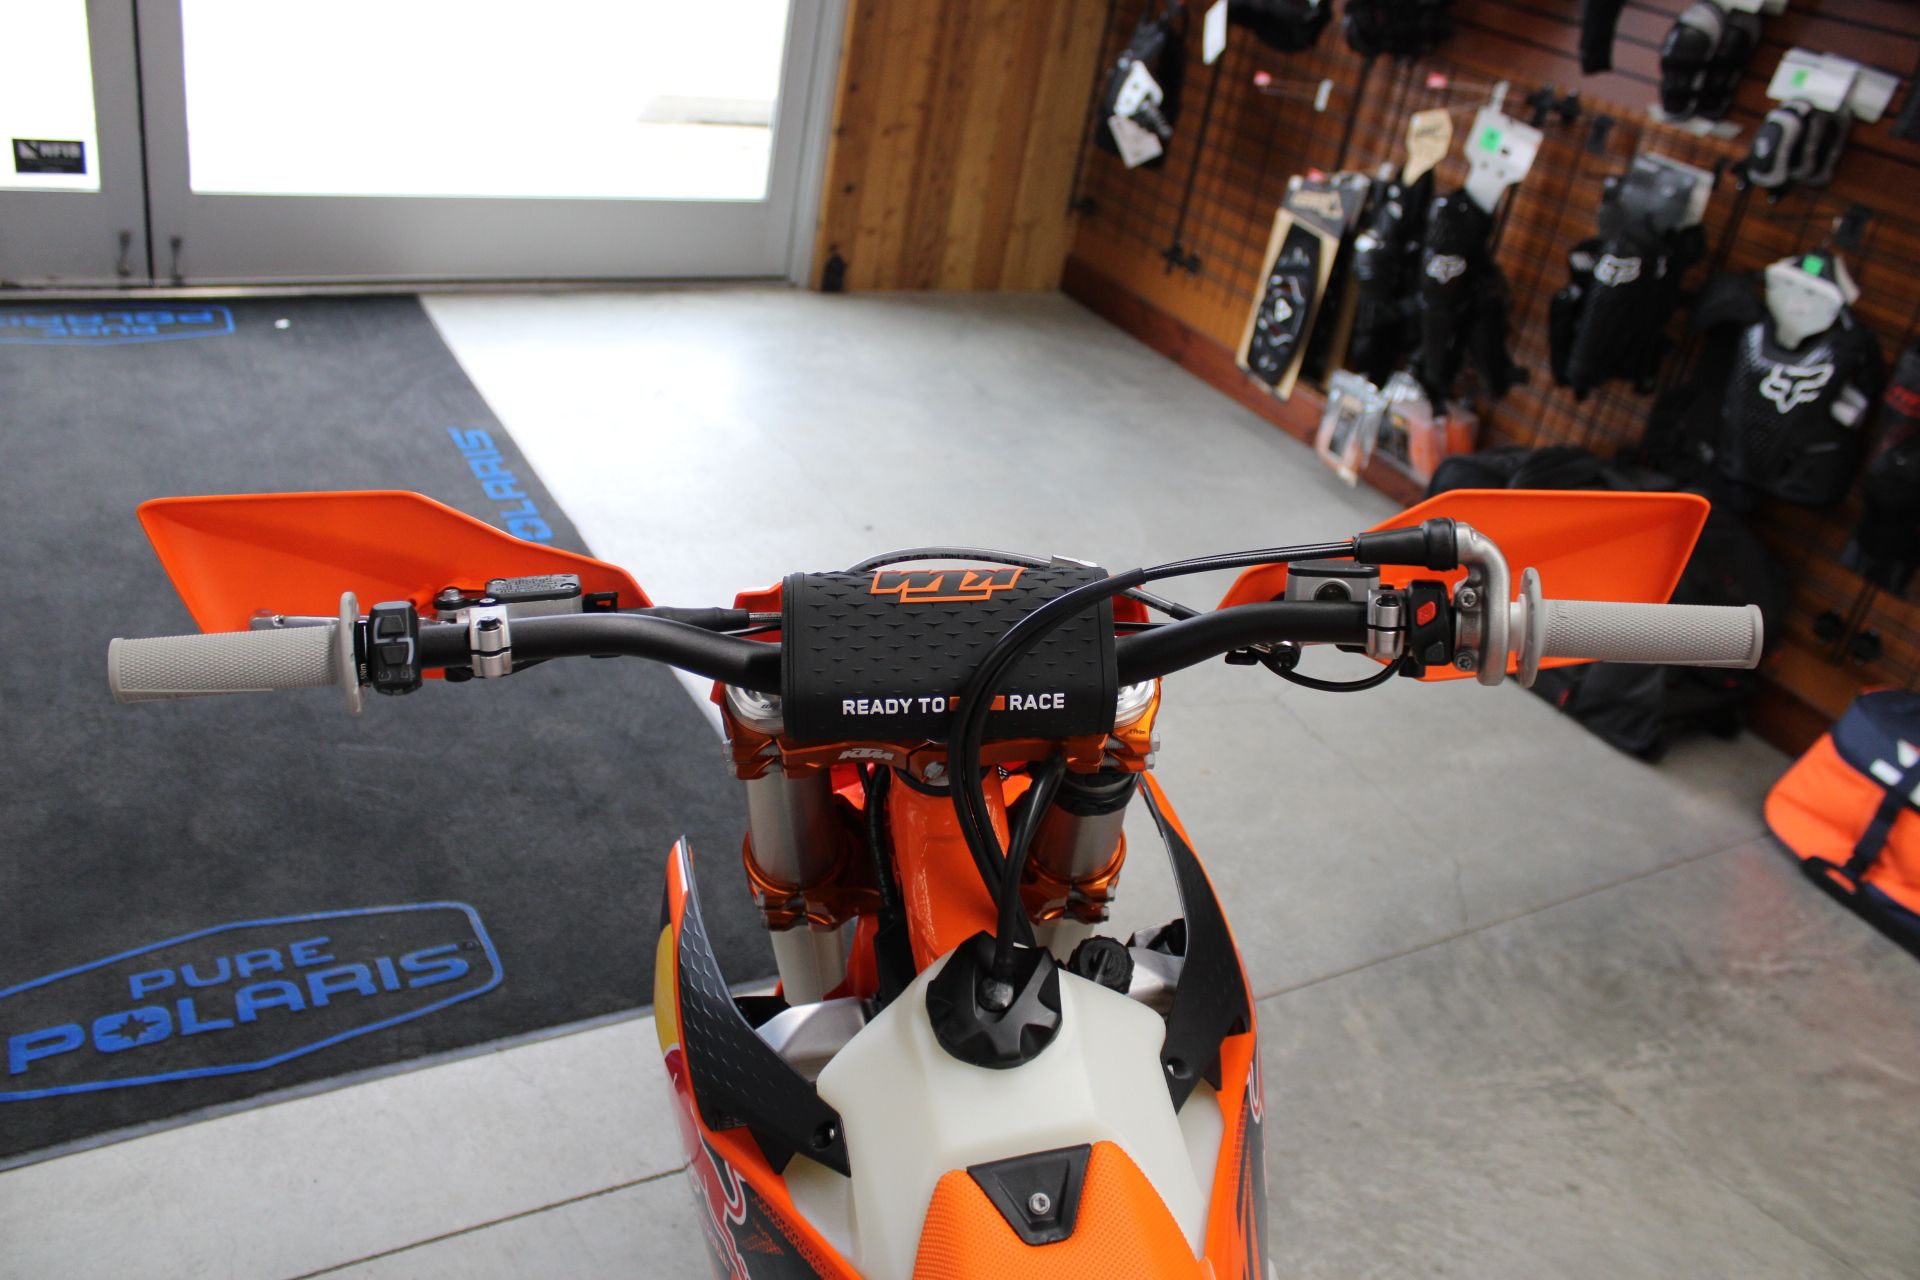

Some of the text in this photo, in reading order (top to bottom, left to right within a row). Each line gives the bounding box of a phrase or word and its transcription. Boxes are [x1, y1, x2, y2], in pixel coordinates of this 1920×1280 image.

[0, 311, 213, 327] POLARI
[842, 693, 1065, 715] READY TO RACE
[838, 748, 894, 761] KTM
[129, 937, 335, 1001] PURE
[8, 943, 469, 1075] POLARIS
